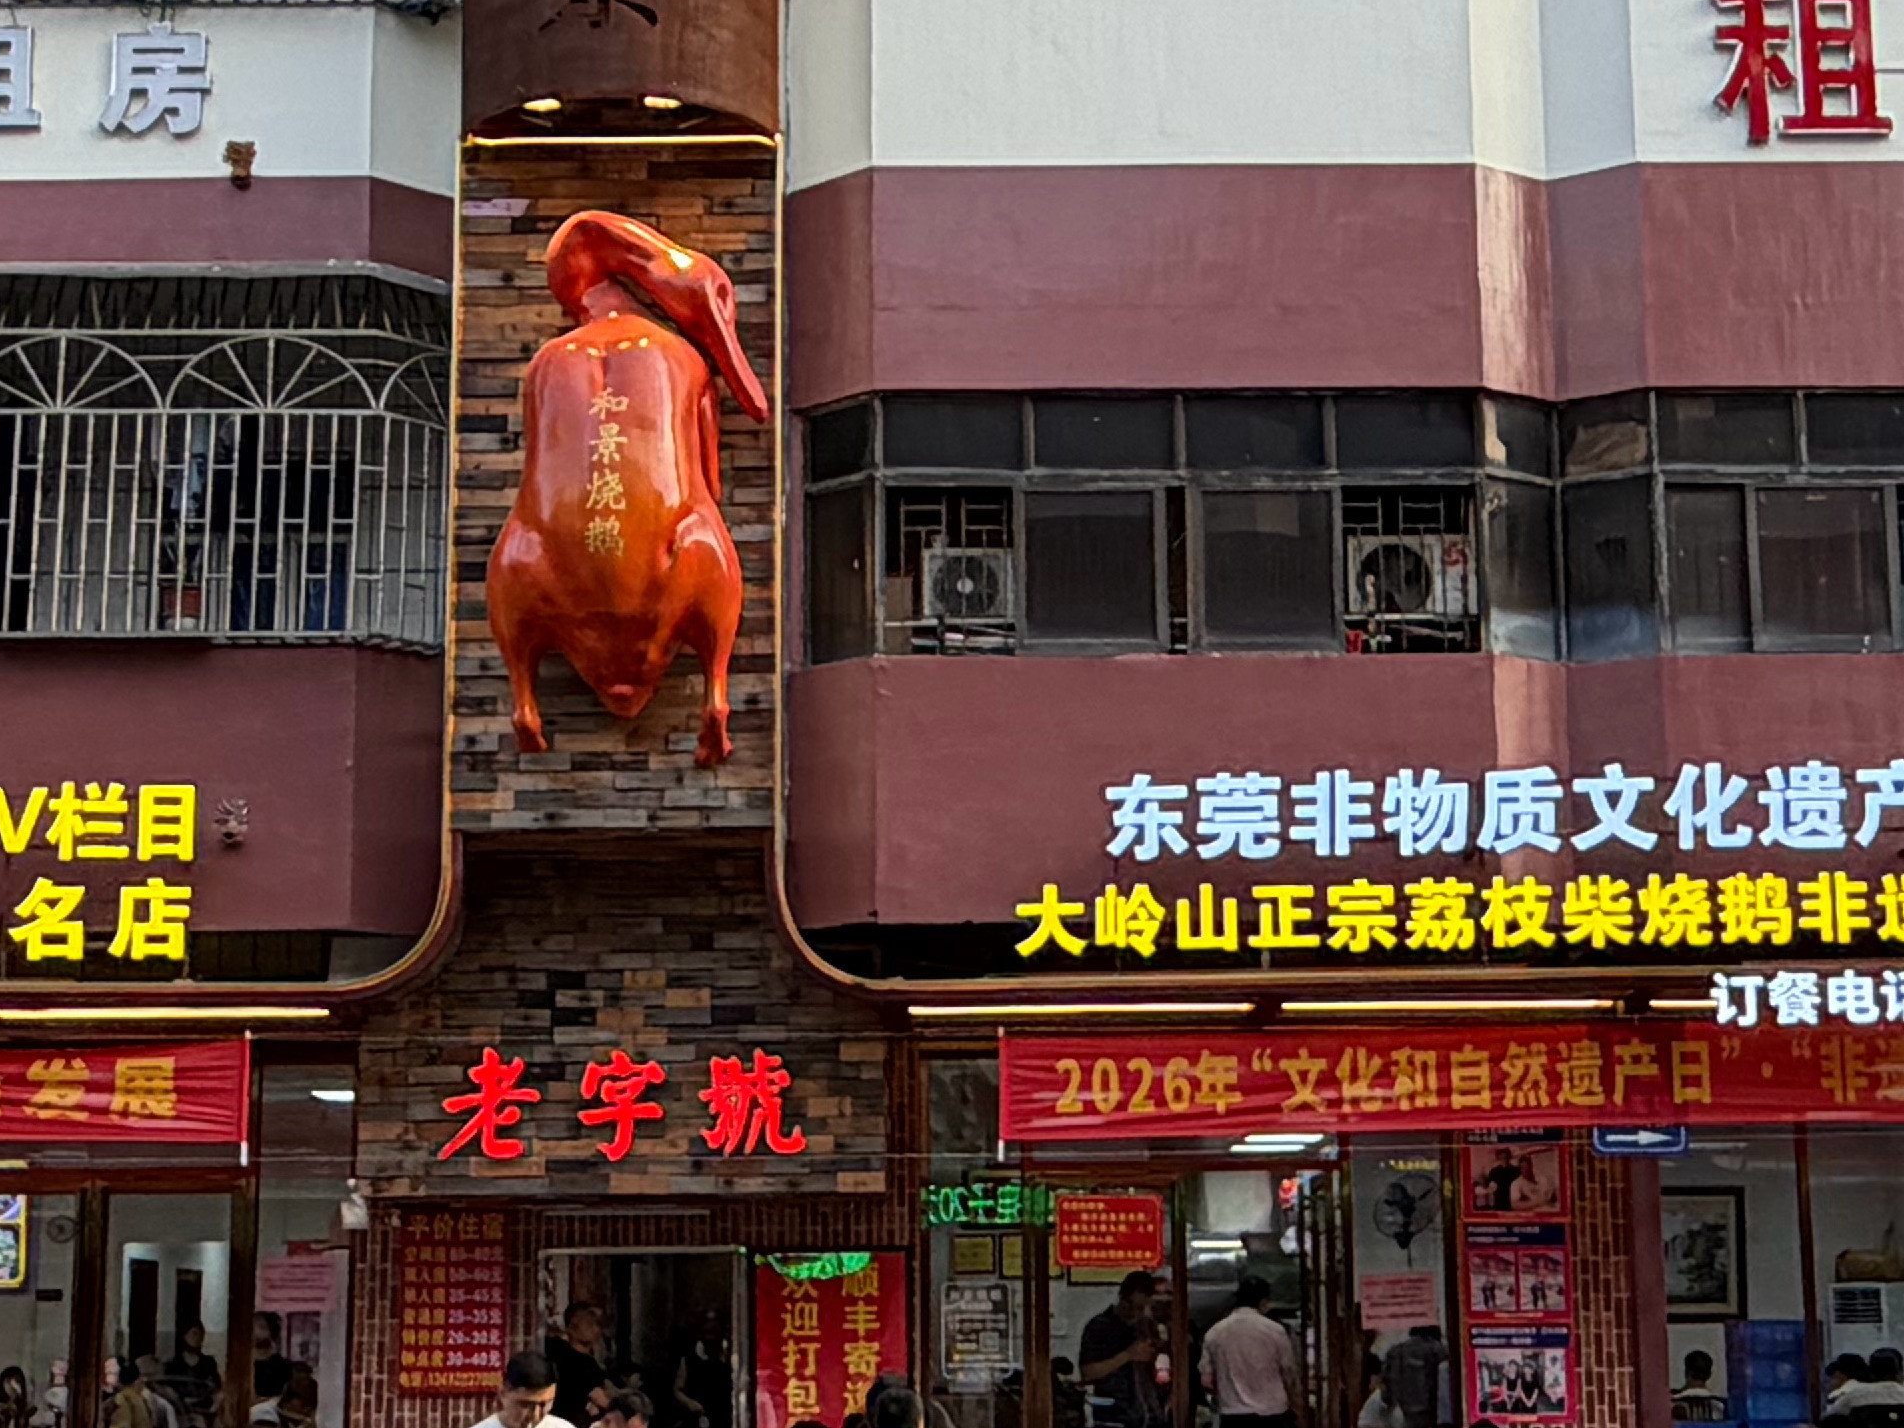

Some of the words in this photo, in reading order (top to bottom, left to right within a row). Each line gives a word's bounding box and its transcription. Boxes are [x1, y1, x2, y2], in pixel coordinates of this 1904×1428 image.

[584, 386, 630, 558] 和景烧鹅
[436, 1046, 808, 1162] 老字號
